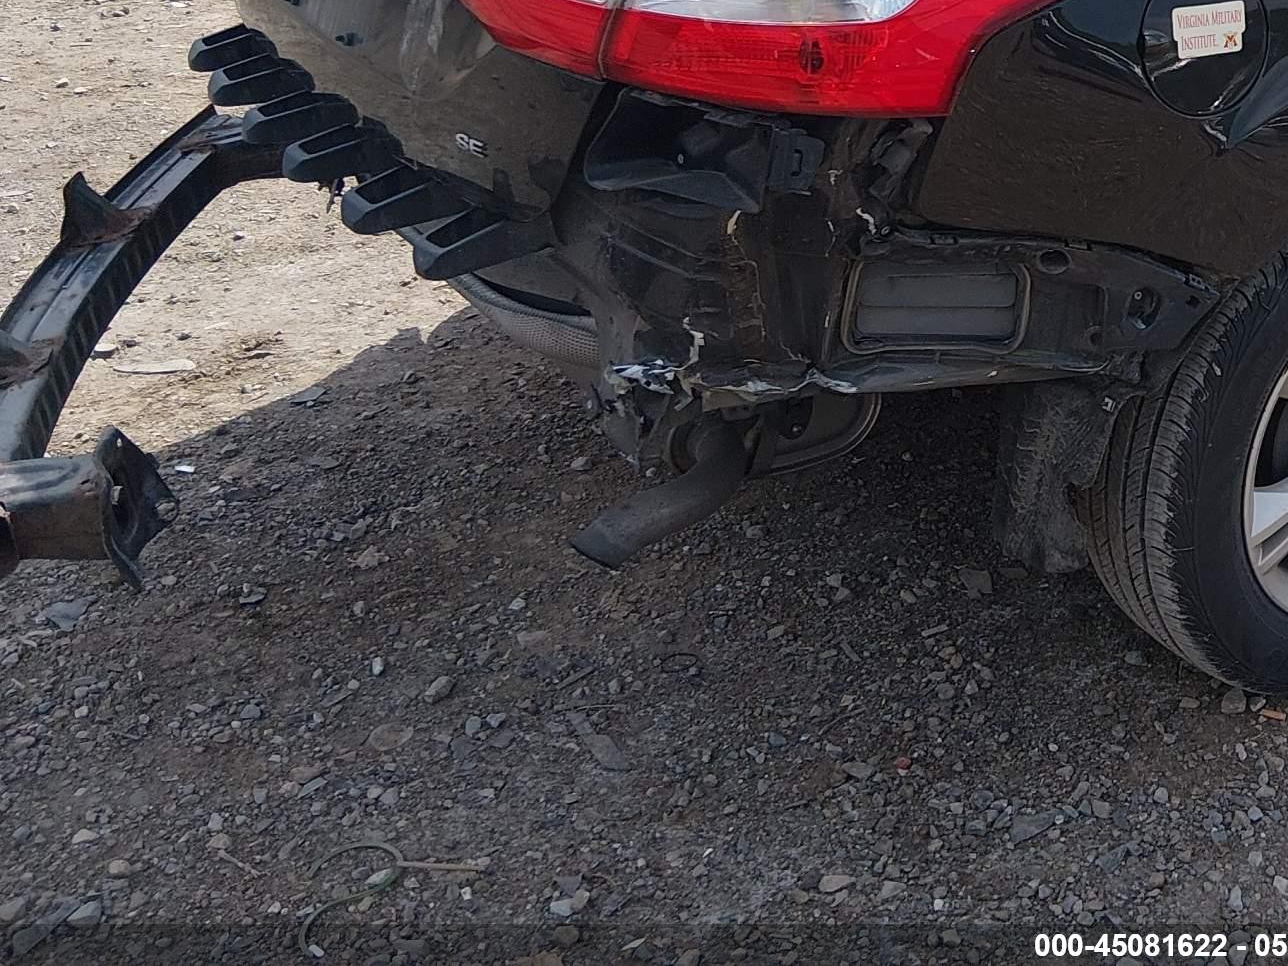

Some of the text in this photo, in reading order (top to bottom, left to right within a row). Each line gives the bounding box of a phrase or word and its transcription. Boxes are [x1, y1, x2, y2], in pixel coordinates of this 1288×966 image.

[1176, 9, 1243, 30] VIRGINIA MILITARY
[1180, 33, 1218, 51] INSTITUTE
[455, 133, 486, 159] SE
